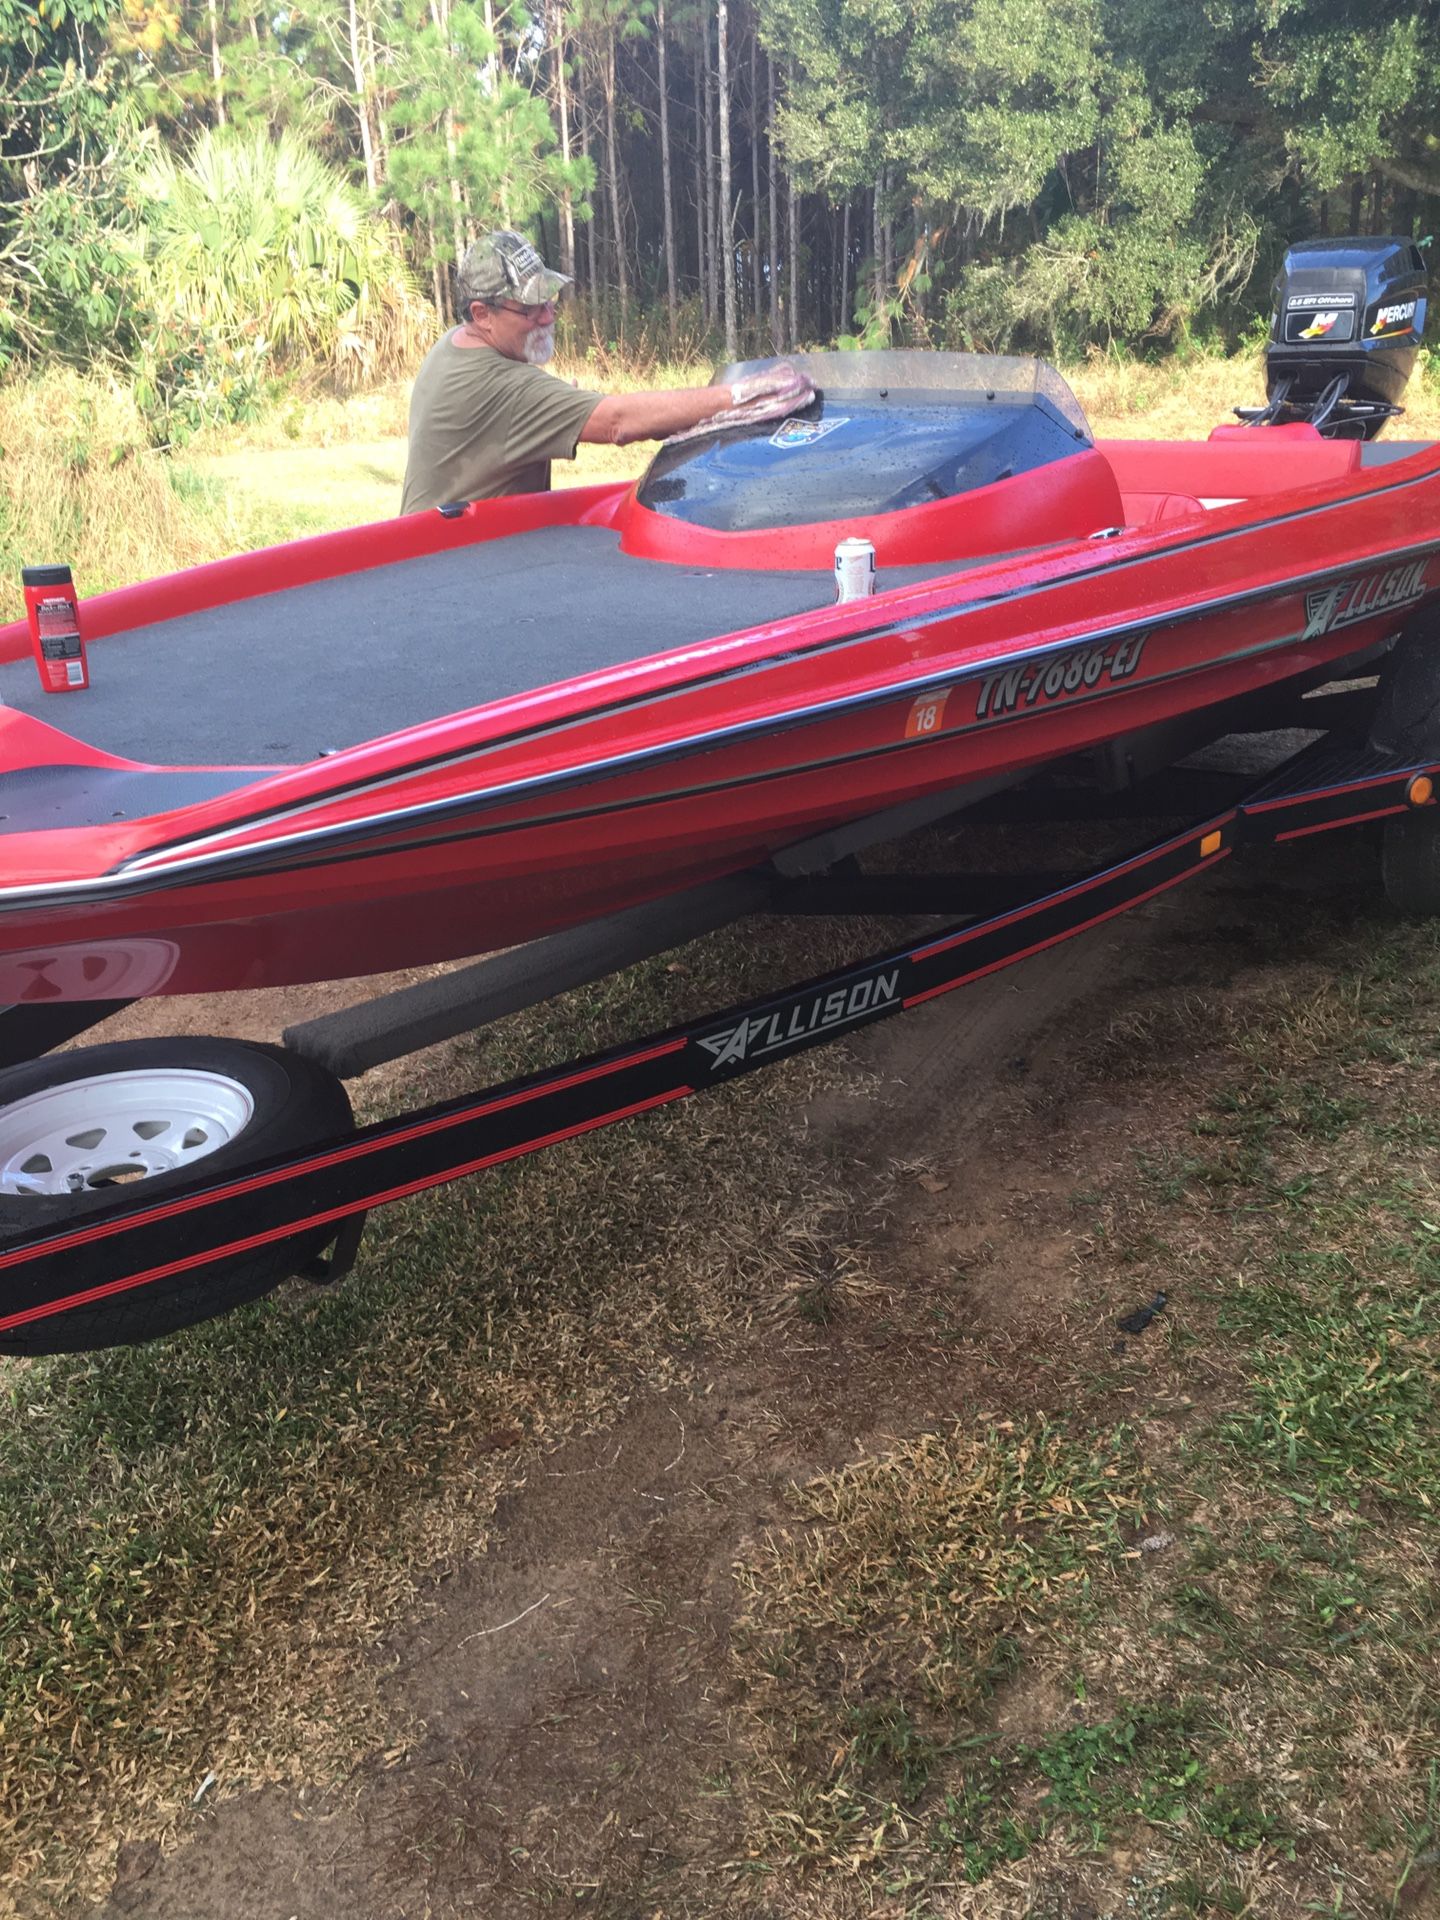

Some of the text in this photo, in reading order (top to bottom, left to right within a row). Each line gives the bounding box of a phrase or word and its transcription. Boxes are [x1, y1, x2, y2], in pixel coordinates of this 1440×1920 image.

[1301, 559, 1430, 641] ALLISON
[976, 631, 1150, 717] TN-7686-EJ
[916, 705, 937, 731] 18
[697, 970, 900, 1070] ALLISON
